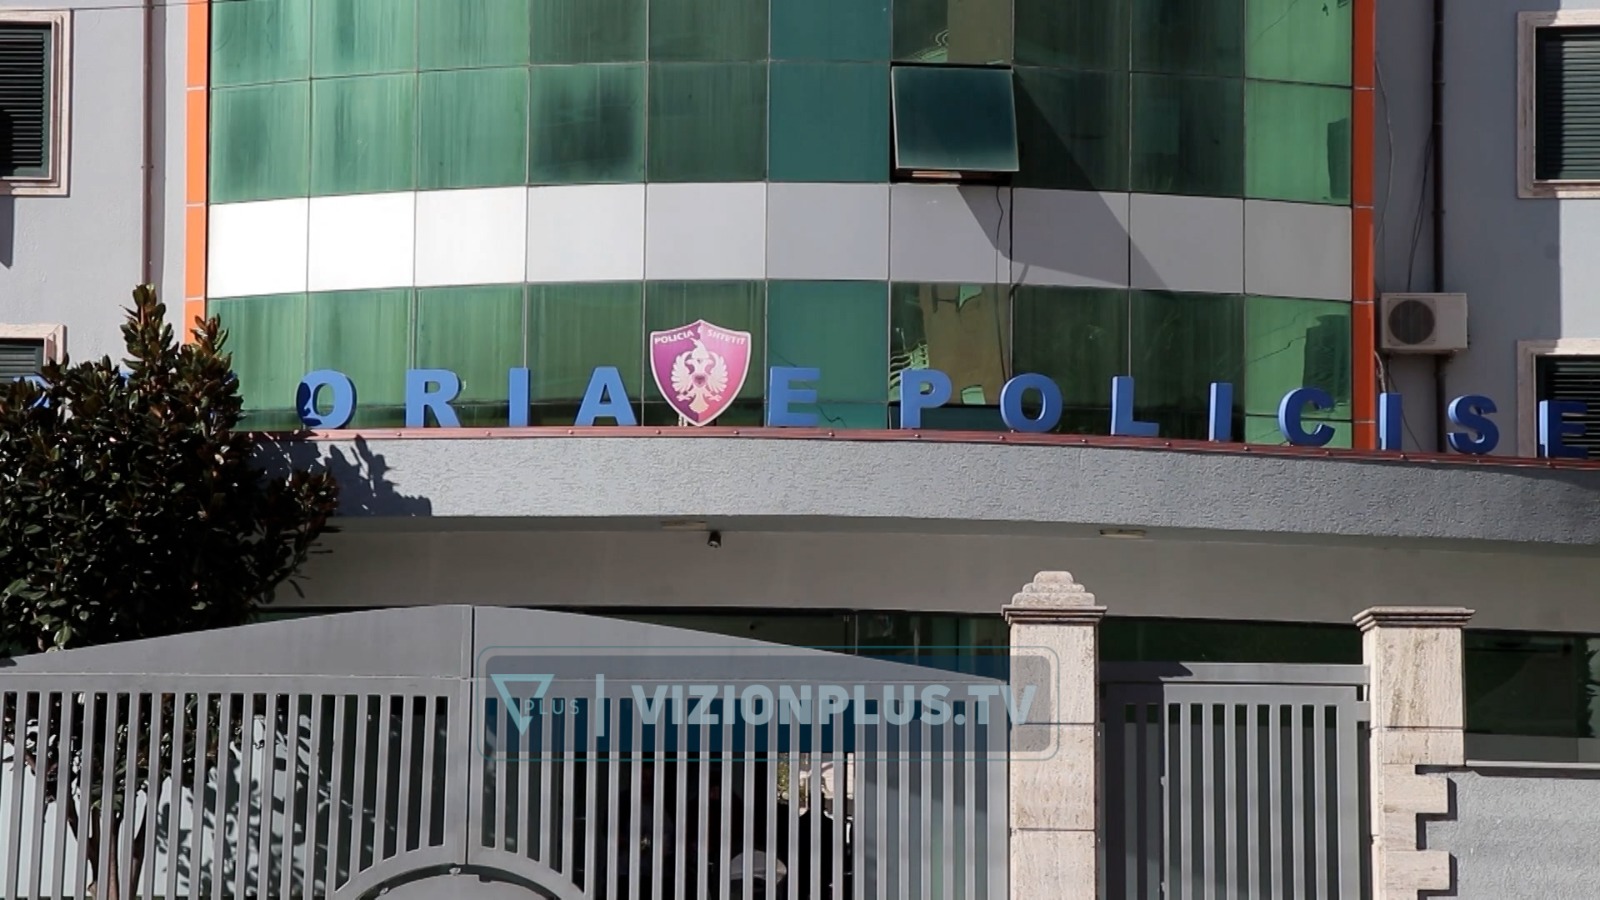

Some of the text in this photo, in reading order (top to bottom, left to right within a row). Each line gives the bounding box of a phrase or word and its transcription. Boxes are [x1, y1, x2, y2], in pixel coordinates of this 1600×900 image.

[655, 330, 694, 344] POLICIA
[767, 366, 821, 428] E
[899, 368, 1589, 460] POLICISE
